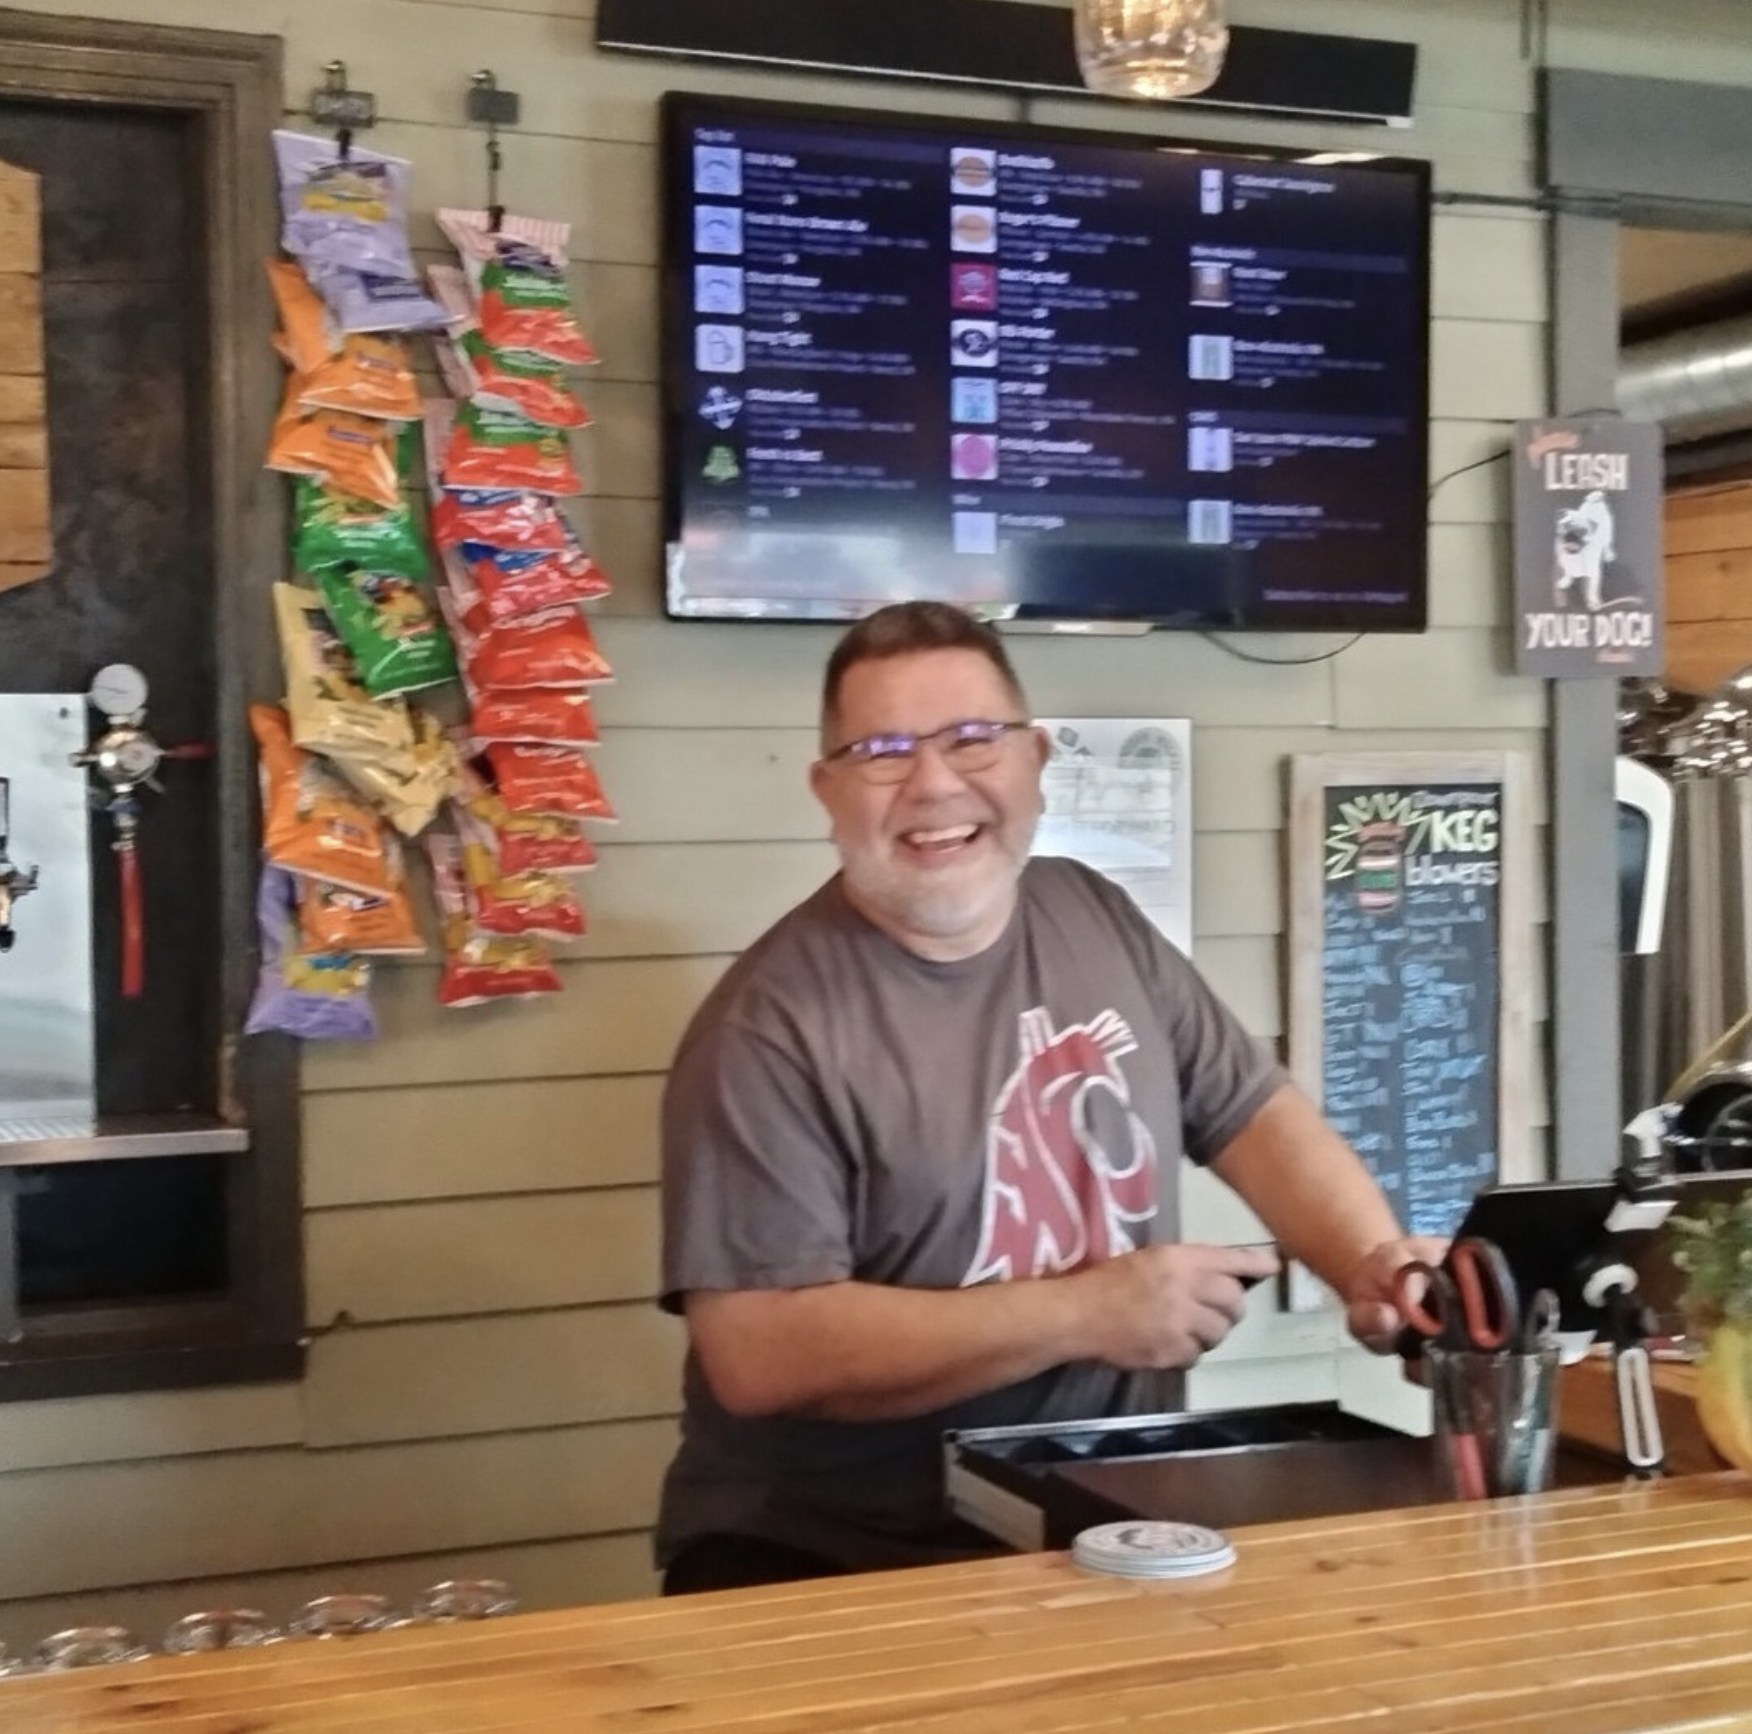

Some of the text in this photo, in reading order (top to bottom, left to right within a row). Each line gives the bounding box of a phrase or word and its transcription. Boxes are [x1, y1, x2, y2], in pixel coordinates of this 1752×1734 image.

[1544, 452, 1629, 490] LEASH
[1525, 611, 1653, 649] YOUR DOG!
[1431, 809, 1499, 853] KEG
